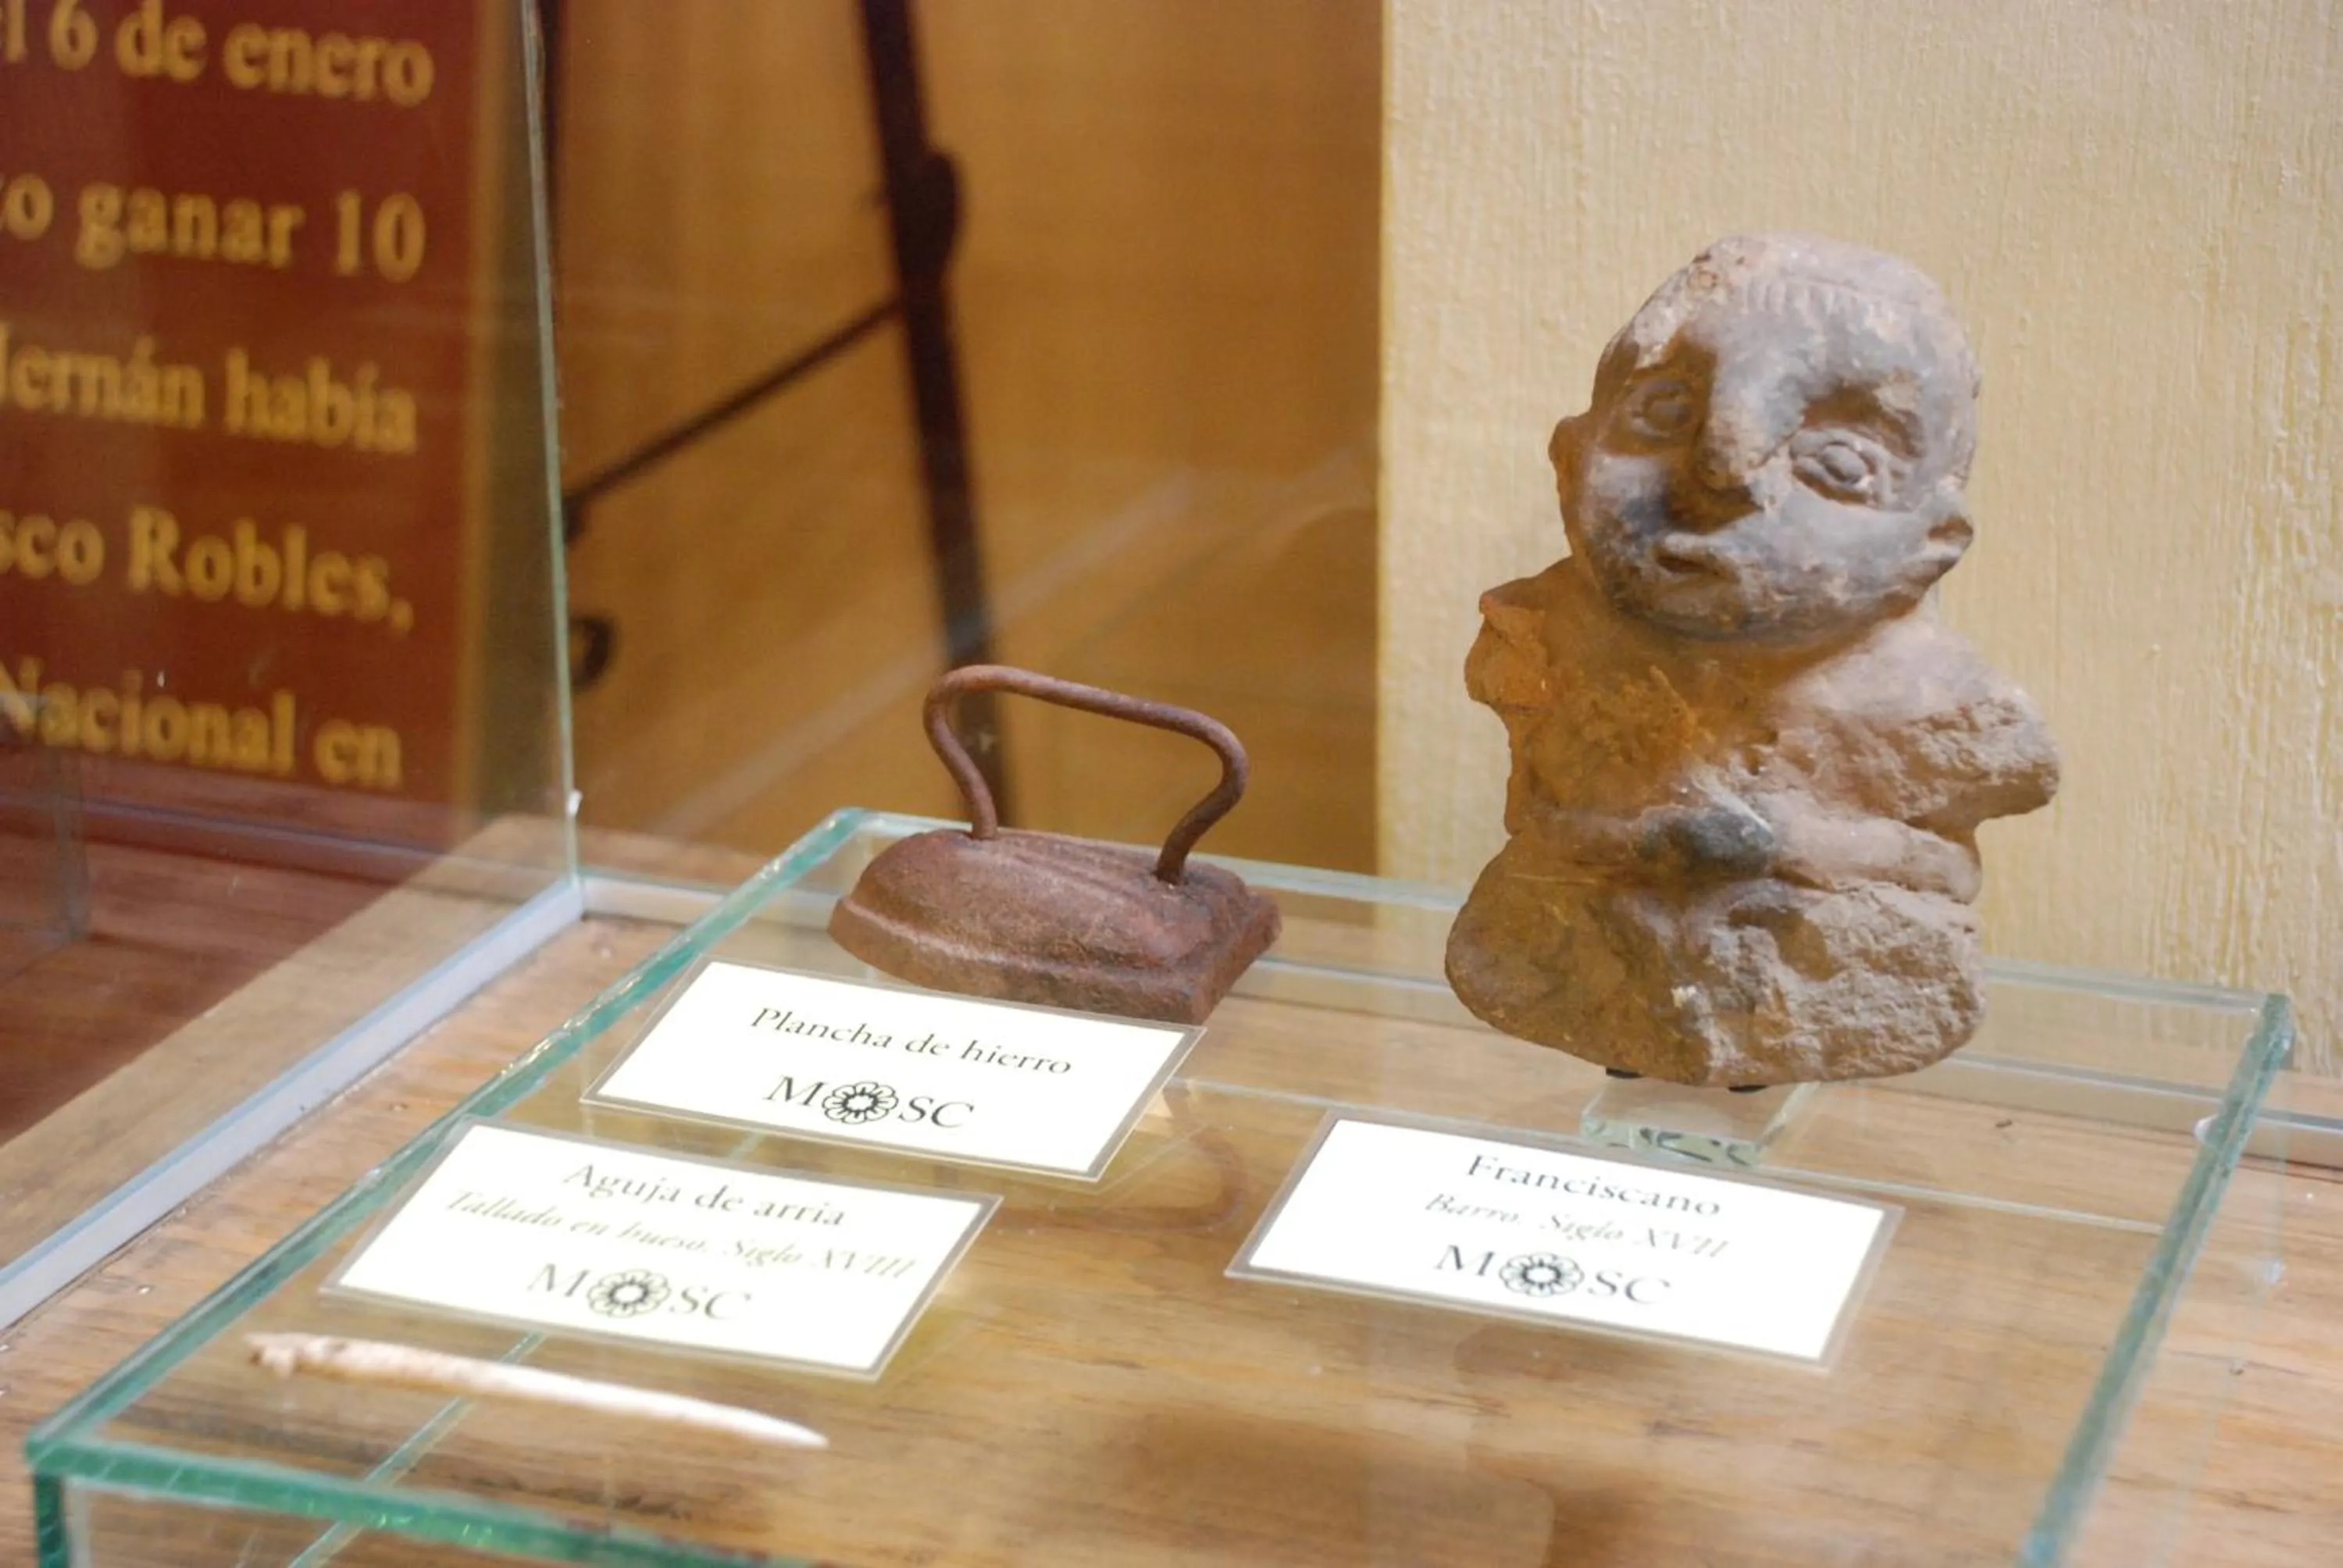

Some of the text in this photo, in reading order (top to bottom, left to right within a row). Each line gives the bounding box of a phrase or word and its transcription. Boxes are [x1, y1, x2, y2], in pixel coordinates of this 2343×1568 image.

[0, 0, 435, 106] l 6 de enero
[0, 172, 426, 283] o ganar 10
[0, 320, 417, 455] ernán había
[127, 504, 414, 636] Robles,
[0, 653, 402, 789] Nacional en
[751, 1006, 1072, 1076] Plancha de hierro
[445, 1189, 562, 1227] Tallado
[570, 1221, 609, 1236] en
[722, 1239, 804, 1268] Siglo
[809, 1248, 917, 1279] XVIII
[562, 1163, 846, 1227] Aguja de arria
[1467, 1154, 1721, 1217] Franciscano
[1539, 1212, 1625, 1243] Siglo
[1634, 1226, 1729, 1259] XVII
